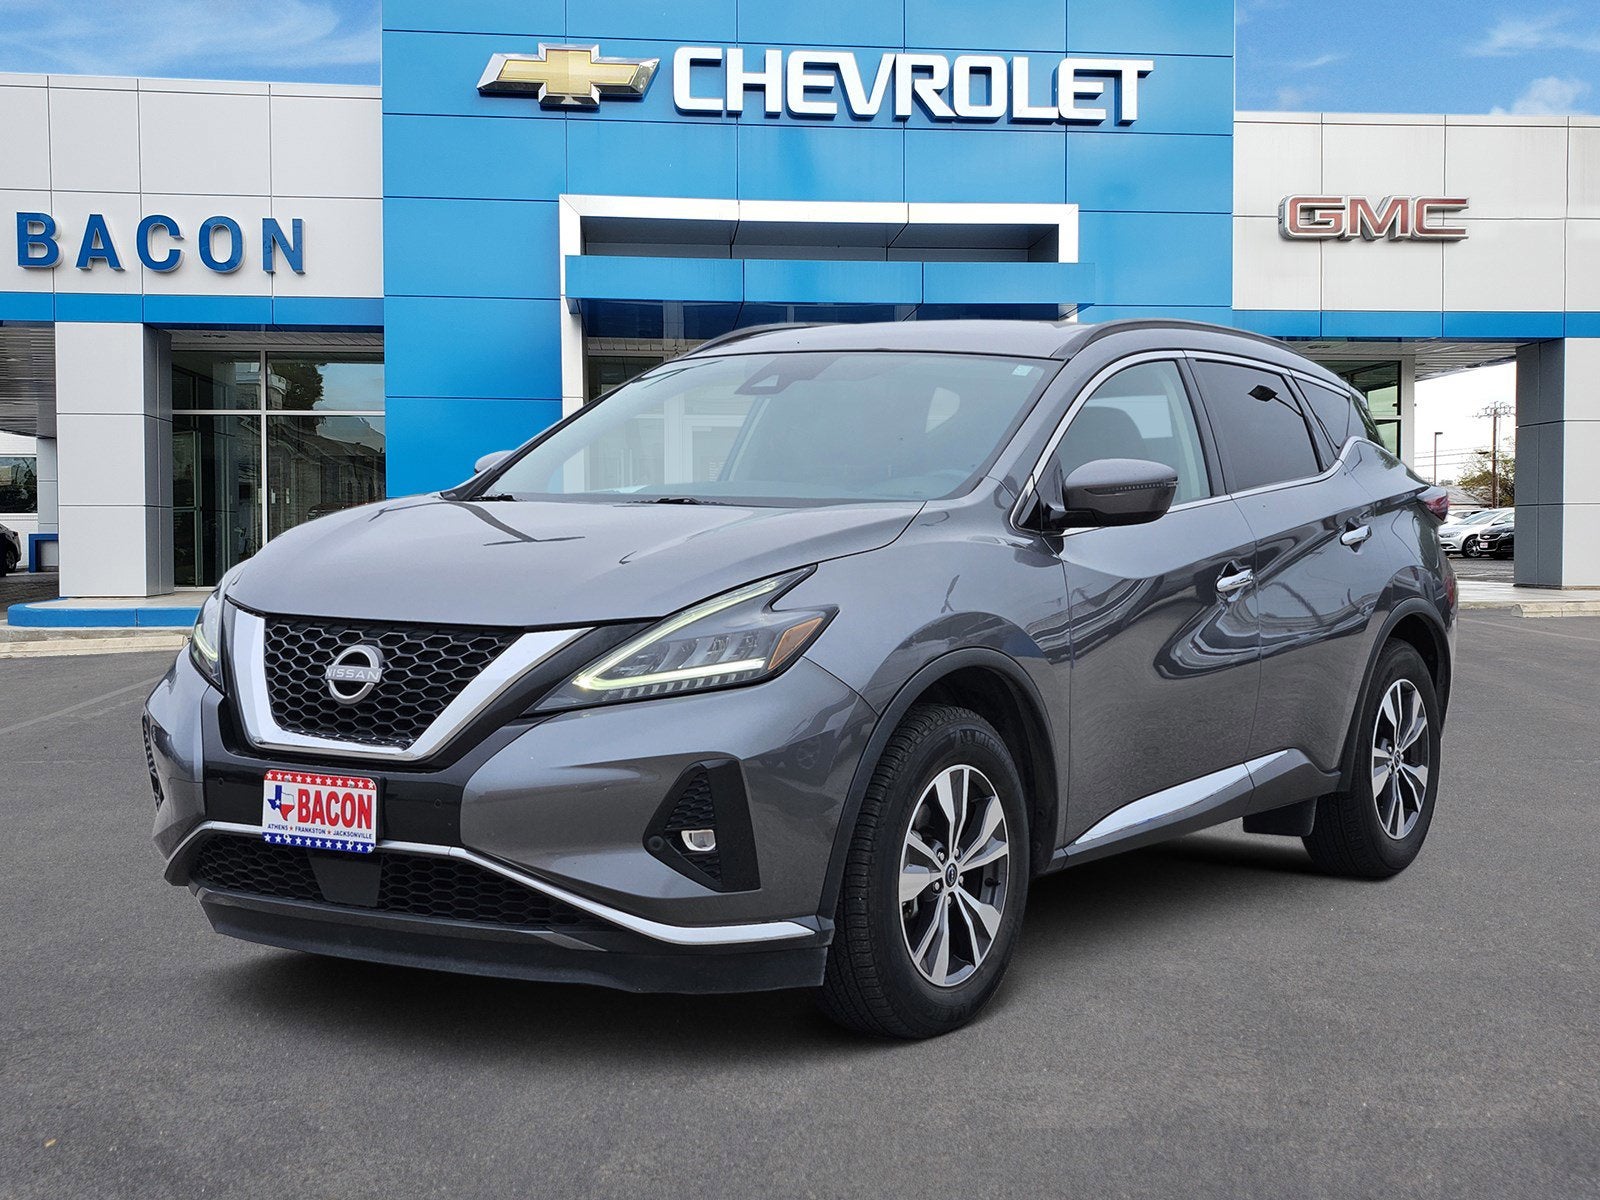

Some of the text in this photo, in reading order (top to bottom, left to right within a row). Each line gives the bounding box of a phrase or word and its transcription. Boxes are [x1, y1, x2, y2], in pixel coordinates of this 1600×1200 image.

[673, 46, 1155, 125] CHEVROLET
[1279, 195, 1469, 241] GMC
[16, 211, 306, 274] BACON
[325, 668, 380, 680] NISSAN
[297, 788, 373, 829] BACON
[267, 823, 373, 839] ATHENS FRANKSTON JACKSONVILLE
